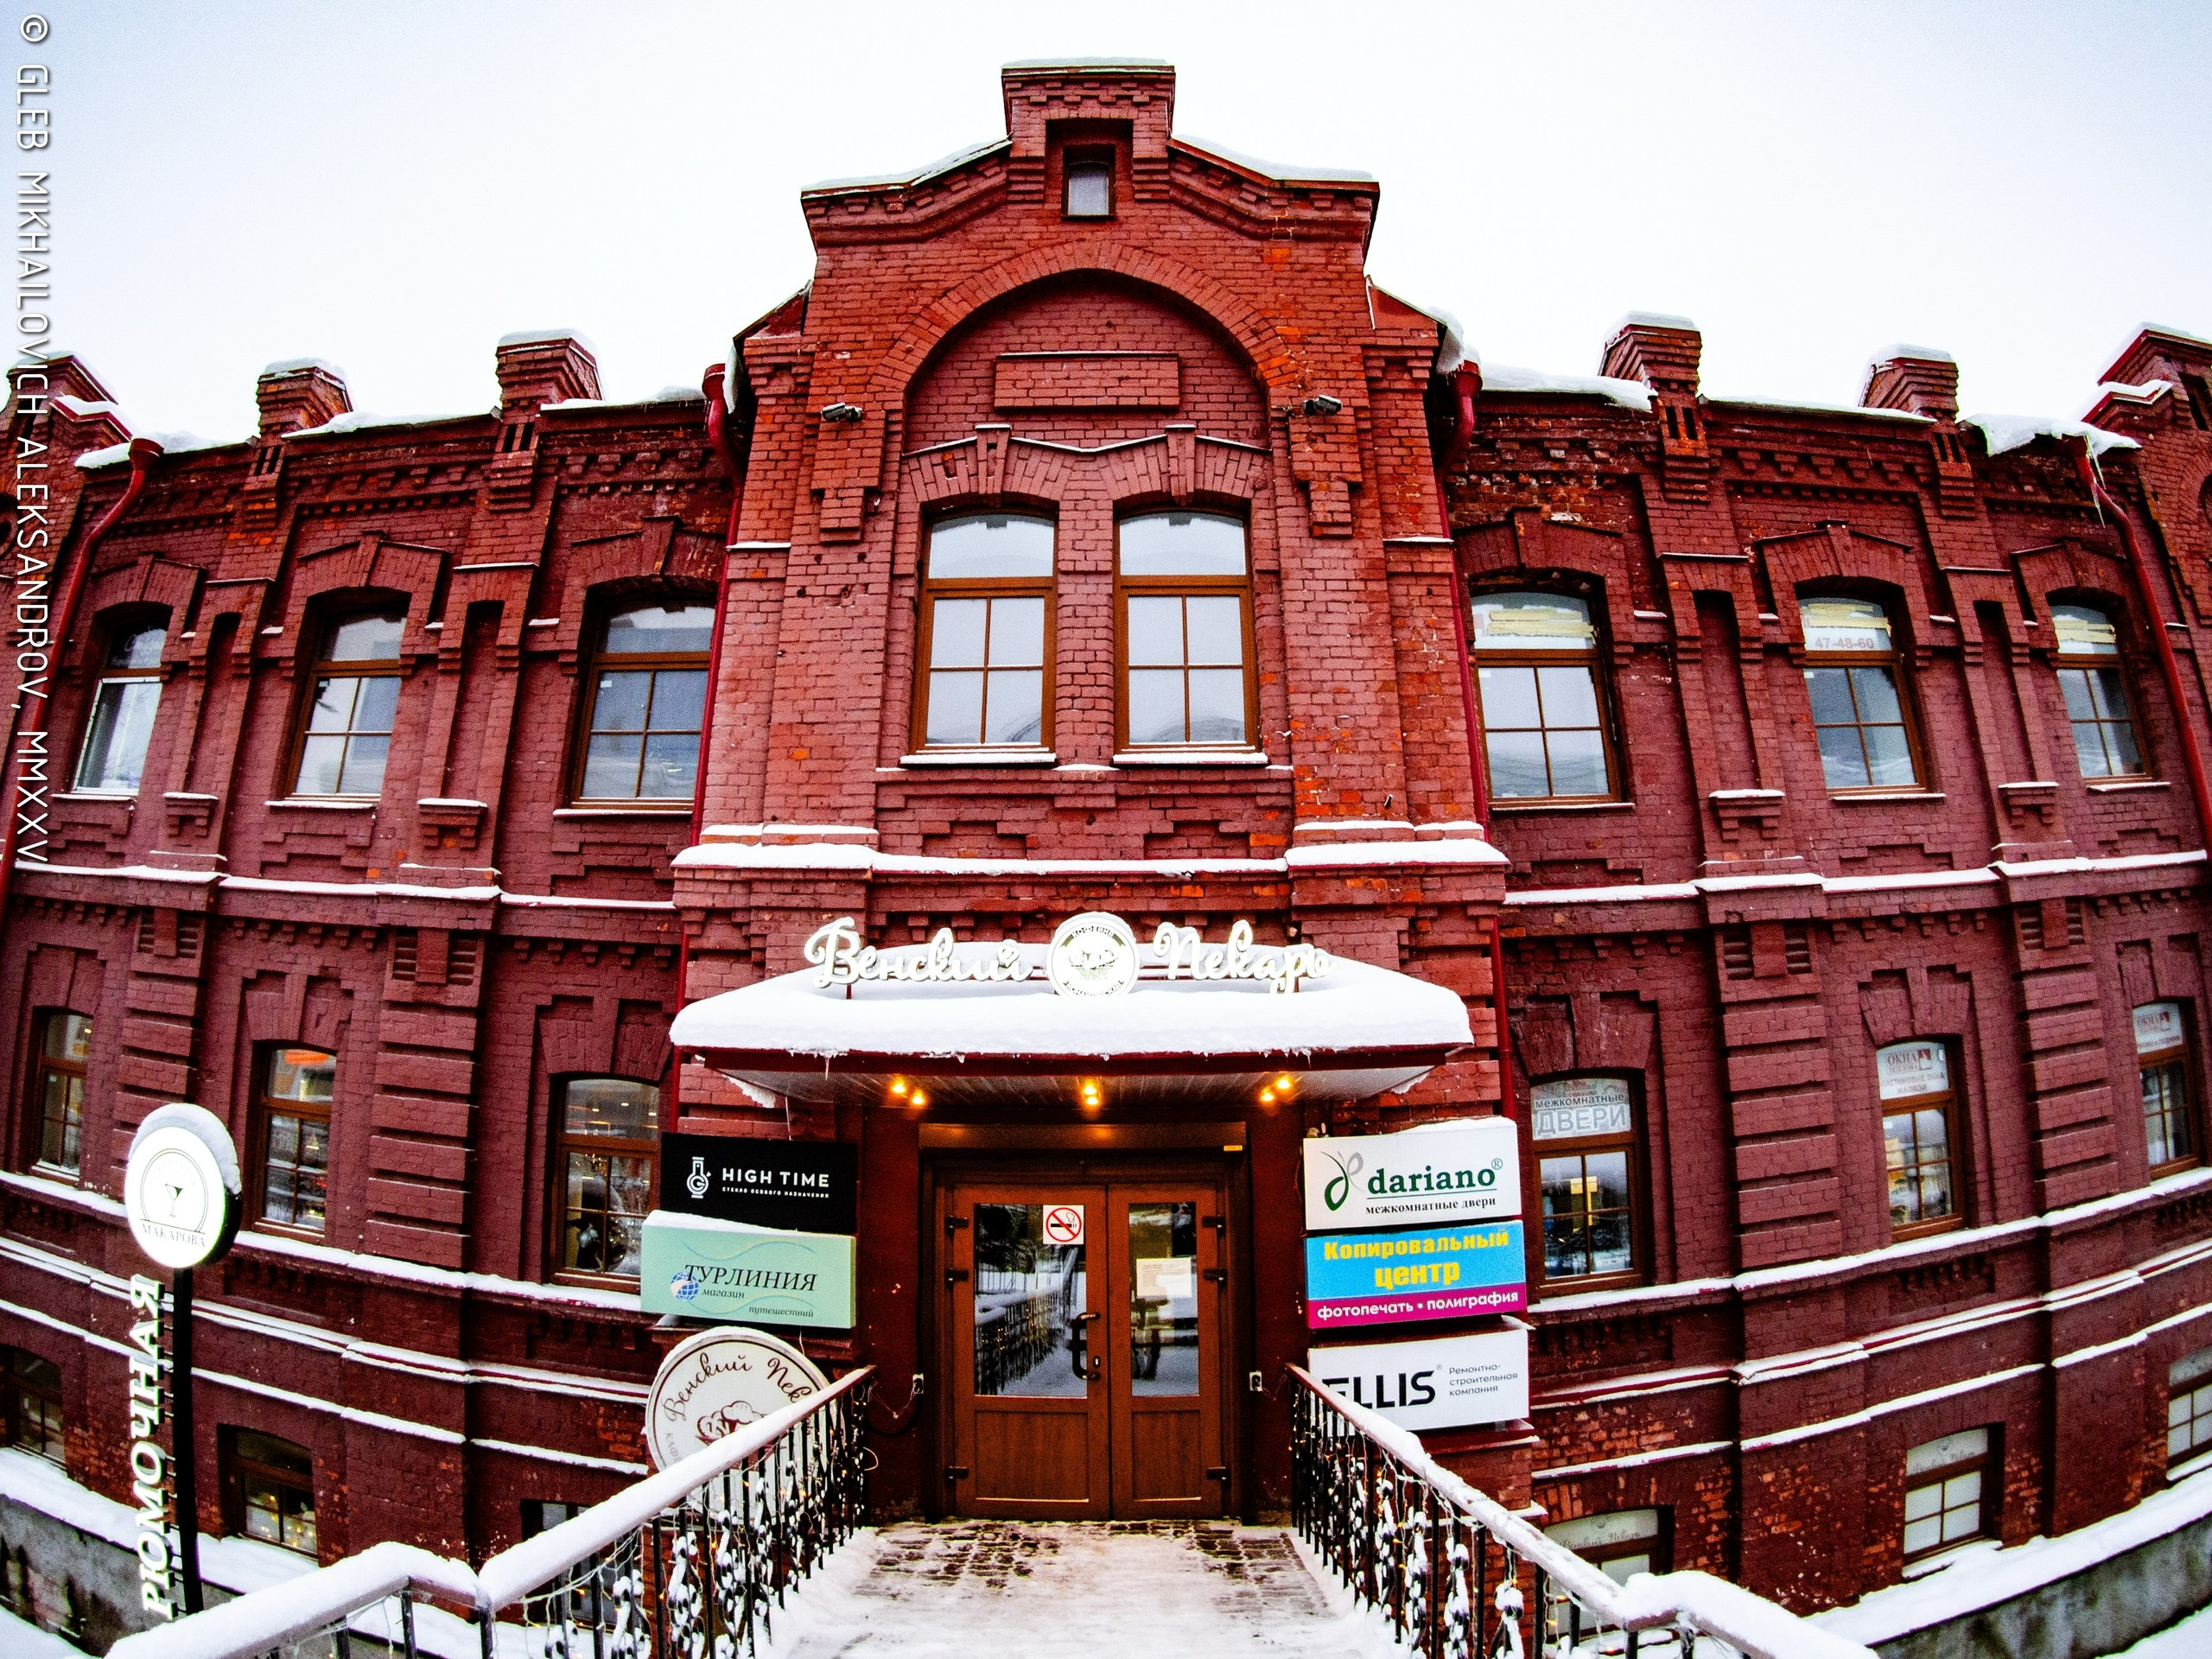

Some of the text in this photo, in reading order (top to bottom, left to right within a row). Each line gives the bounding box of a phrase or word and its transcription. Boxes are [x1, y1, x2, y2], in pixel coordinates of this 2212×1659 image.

[804, 920, 1337, 994] Венский Пекарь
[1535, 1093, 1625, 1109] межкомнатные
[1537, 1105, 1626, 1136] ДВЕРИ
[722, 1167, 830, 1188] HIGH TIME
[1366, 1198, 1497, 1215] межкомнатные двери
[142, 1224, 207, 1248] МАКАРОВА
[1324, 1228, 1510, 1260] Копировальный
[684, 1264, 817, 1292] ТУРЛИНИЯ
[1375, 1262, 1460, 1290] центр
[702, 1288, 746, 1300] магазин
[1317, 1291, 1519, 1320] фотопечать полиграфия
[748, 1306, 815, 1318] путешествий
[1449, 1363, 1502, 1376] Ремонтно-
[1449, 1372, 1518, 1386] строительная
[661, 1352, 812, 1422] Венский Пек
[1449, 1384, 1498, 1396] компания
[130, 1274, 174, 1620] РЮМОЧНАЯ
